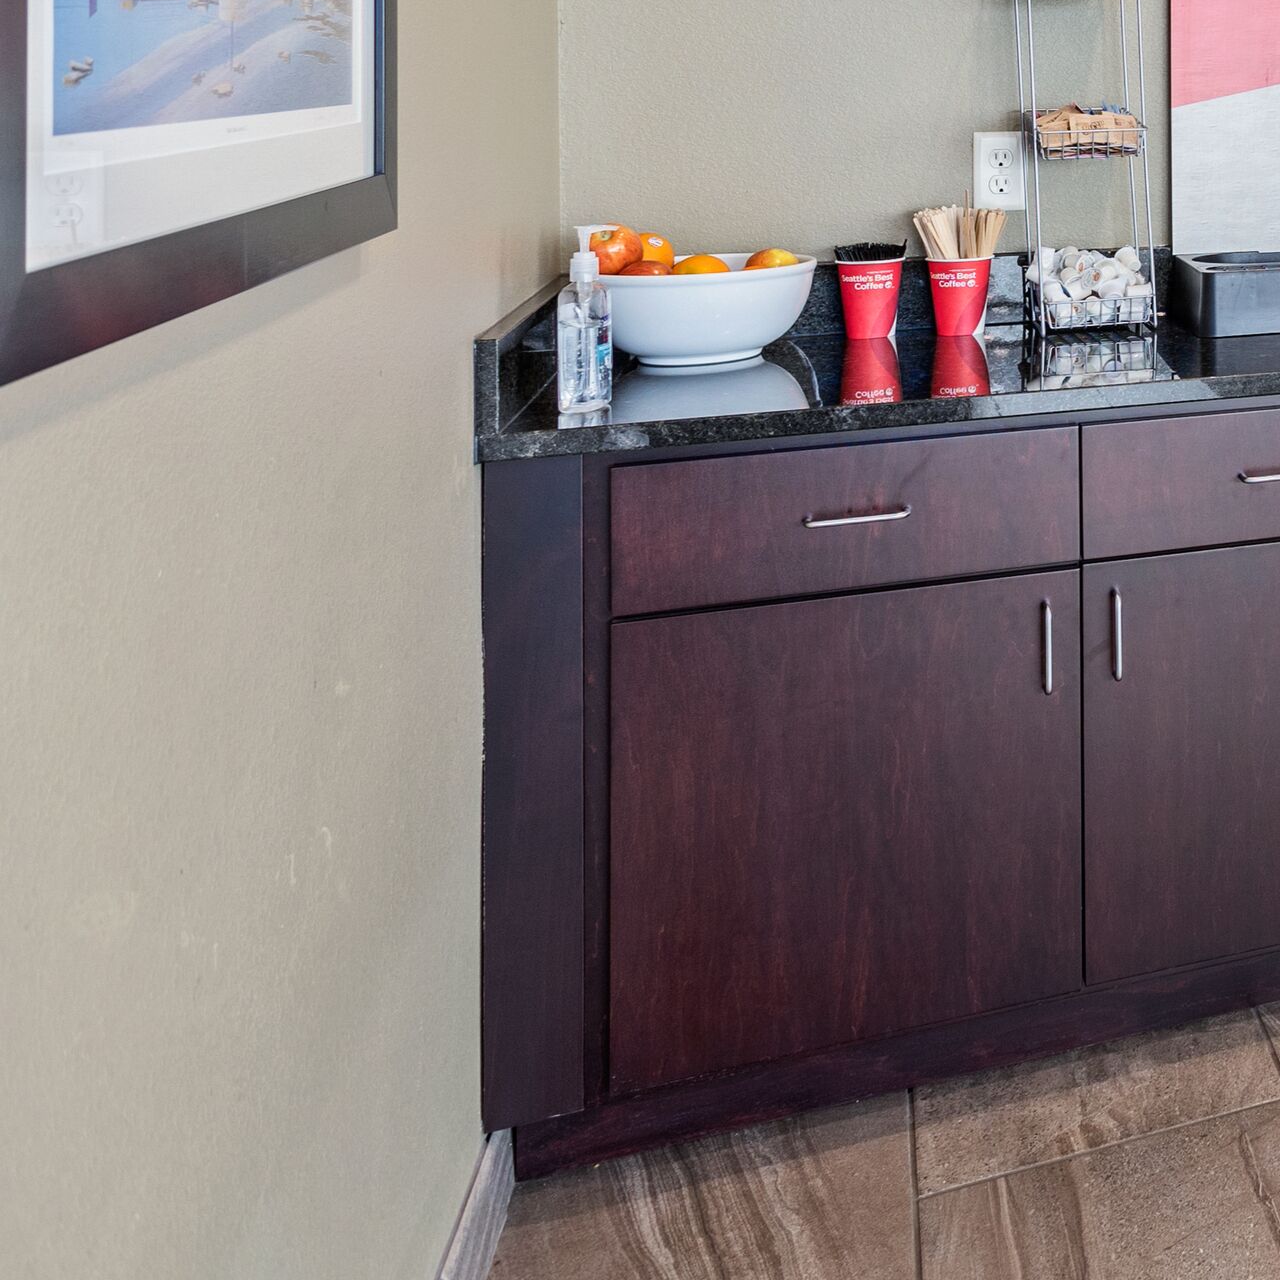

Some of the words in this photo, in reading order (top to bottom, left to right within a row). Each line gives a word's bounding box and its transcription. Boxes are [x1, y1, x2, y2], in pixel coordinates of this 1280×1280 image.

[874, 273, 893, 281] Best
[854, 282, 883, 290] Coffee
[939, 280, 967, 288] Coffee
